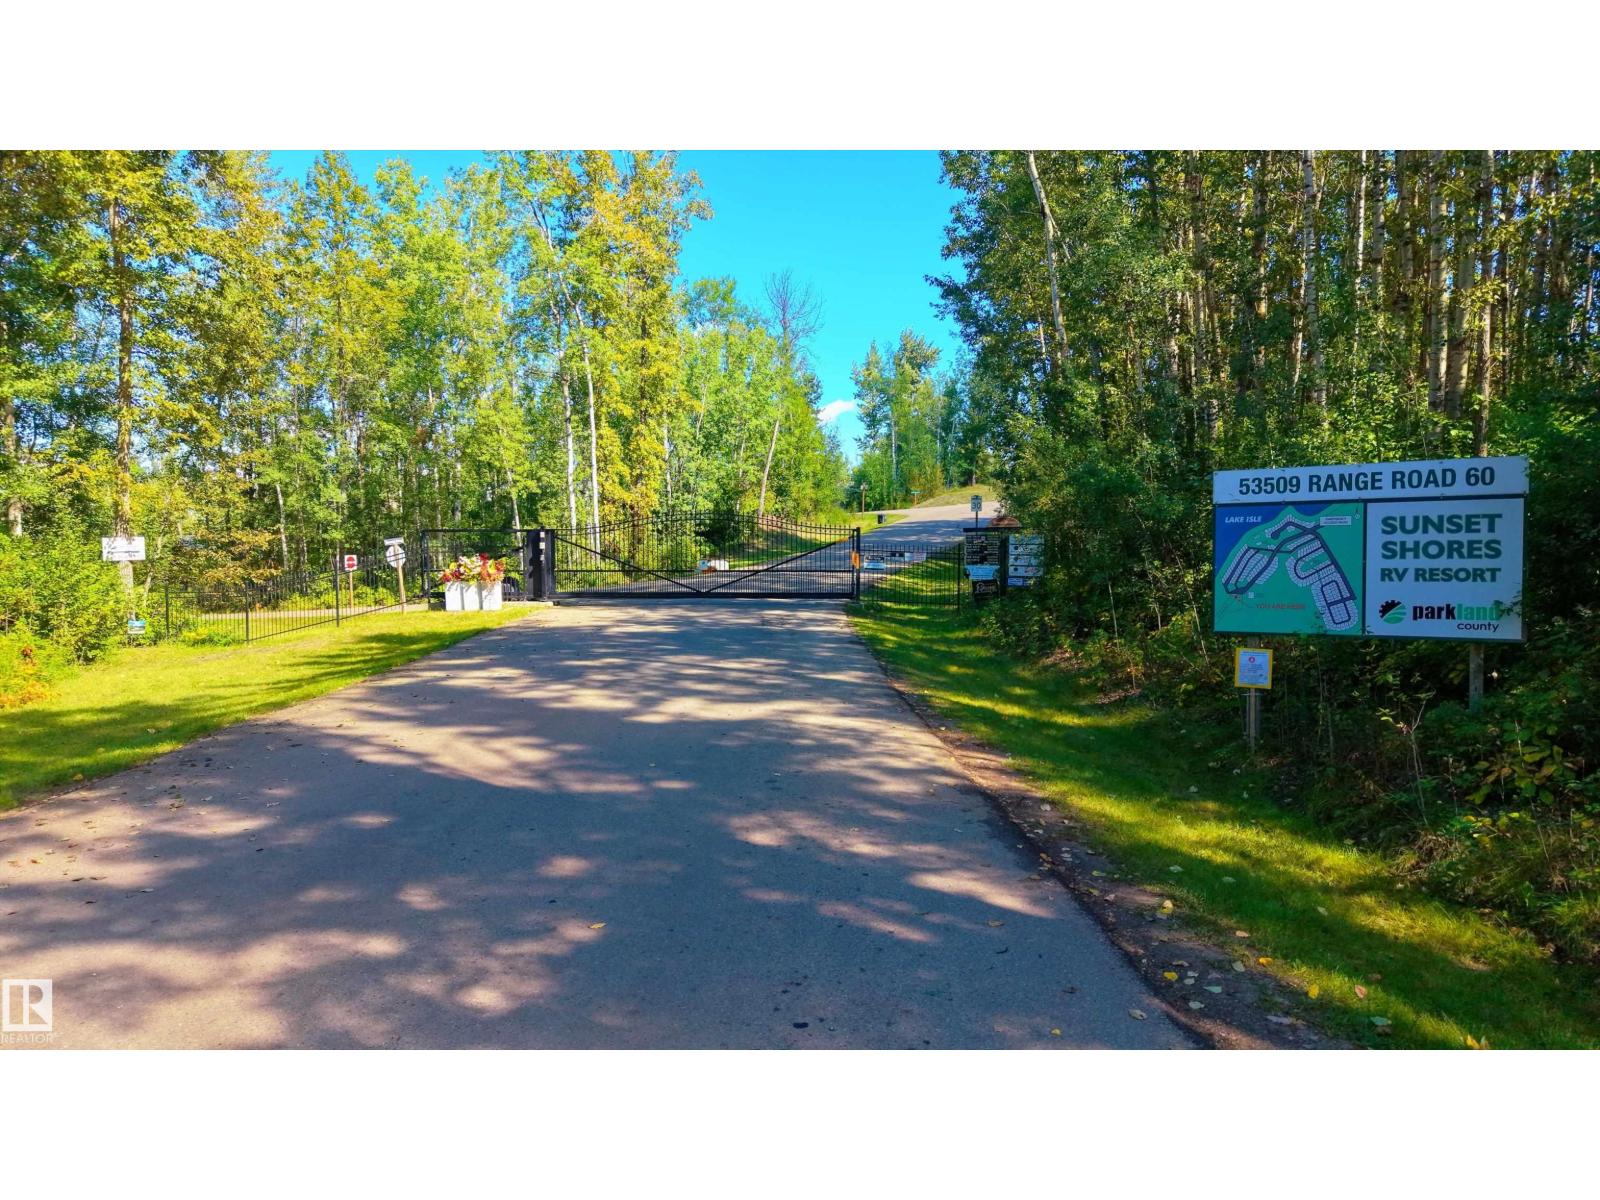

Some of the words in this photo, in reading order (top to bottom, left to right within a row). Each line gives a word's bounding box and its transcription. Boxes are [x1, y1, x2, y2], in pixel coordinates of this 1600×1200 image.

[1238, 475, 1300, 495] 53509
[1308, 471, 1383, 493] RANGE
[1391, 468, 1456, 490] ROAD
[1465, 466, 1495, 487] 60
[1245, 515, 1262, 523] ISLE
[1381, 513, 1503, 535] SUNSET
[1381, 539, 1503, 560] SHORES
[1380, 568, 1408, 583] RV
[1414, 567, 1502, 583] RESORT
[1412, 602, 1500, 620] parkland
[1457, 622, 1500, 633] county
